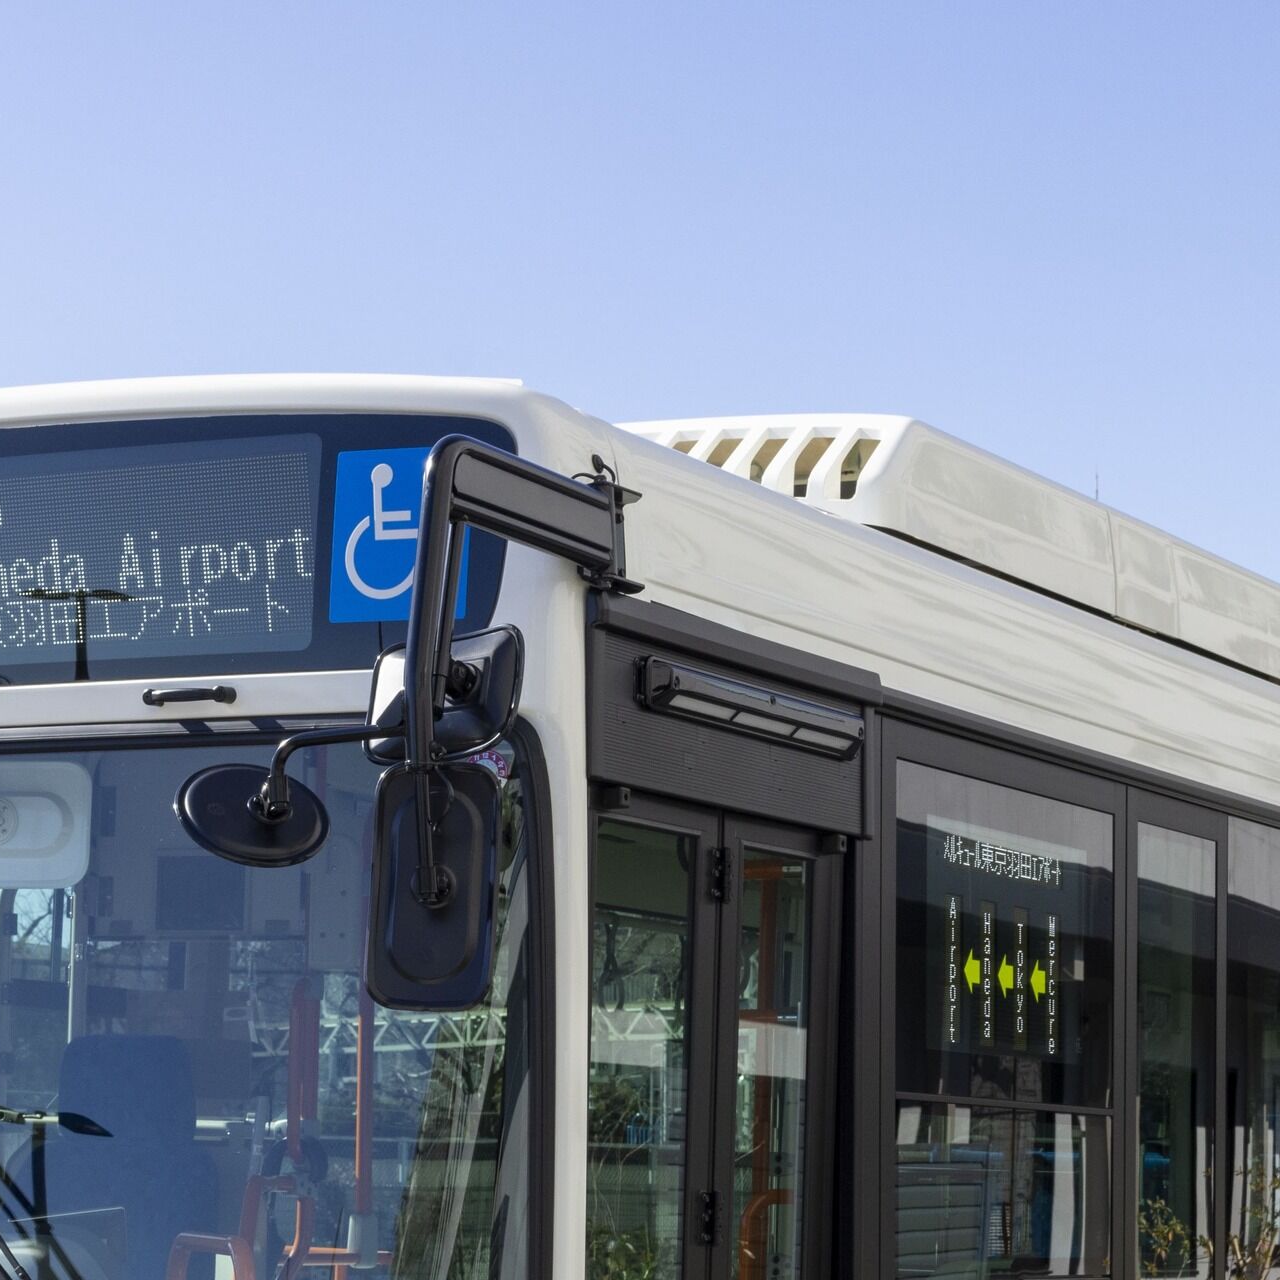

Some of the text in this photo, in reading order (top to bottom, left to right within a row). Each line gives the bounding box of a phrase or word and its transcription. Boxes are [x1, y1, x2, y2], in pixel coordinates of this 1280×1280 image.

[119, 528, 312, 590] Airport
[948, 896, 958, 1043] Airport
[982, 911, 992, 1039] Haneda
[1015, 922, 1025, 1034] Tokyo
[1047, 914, 1057, 1055] Mercure
